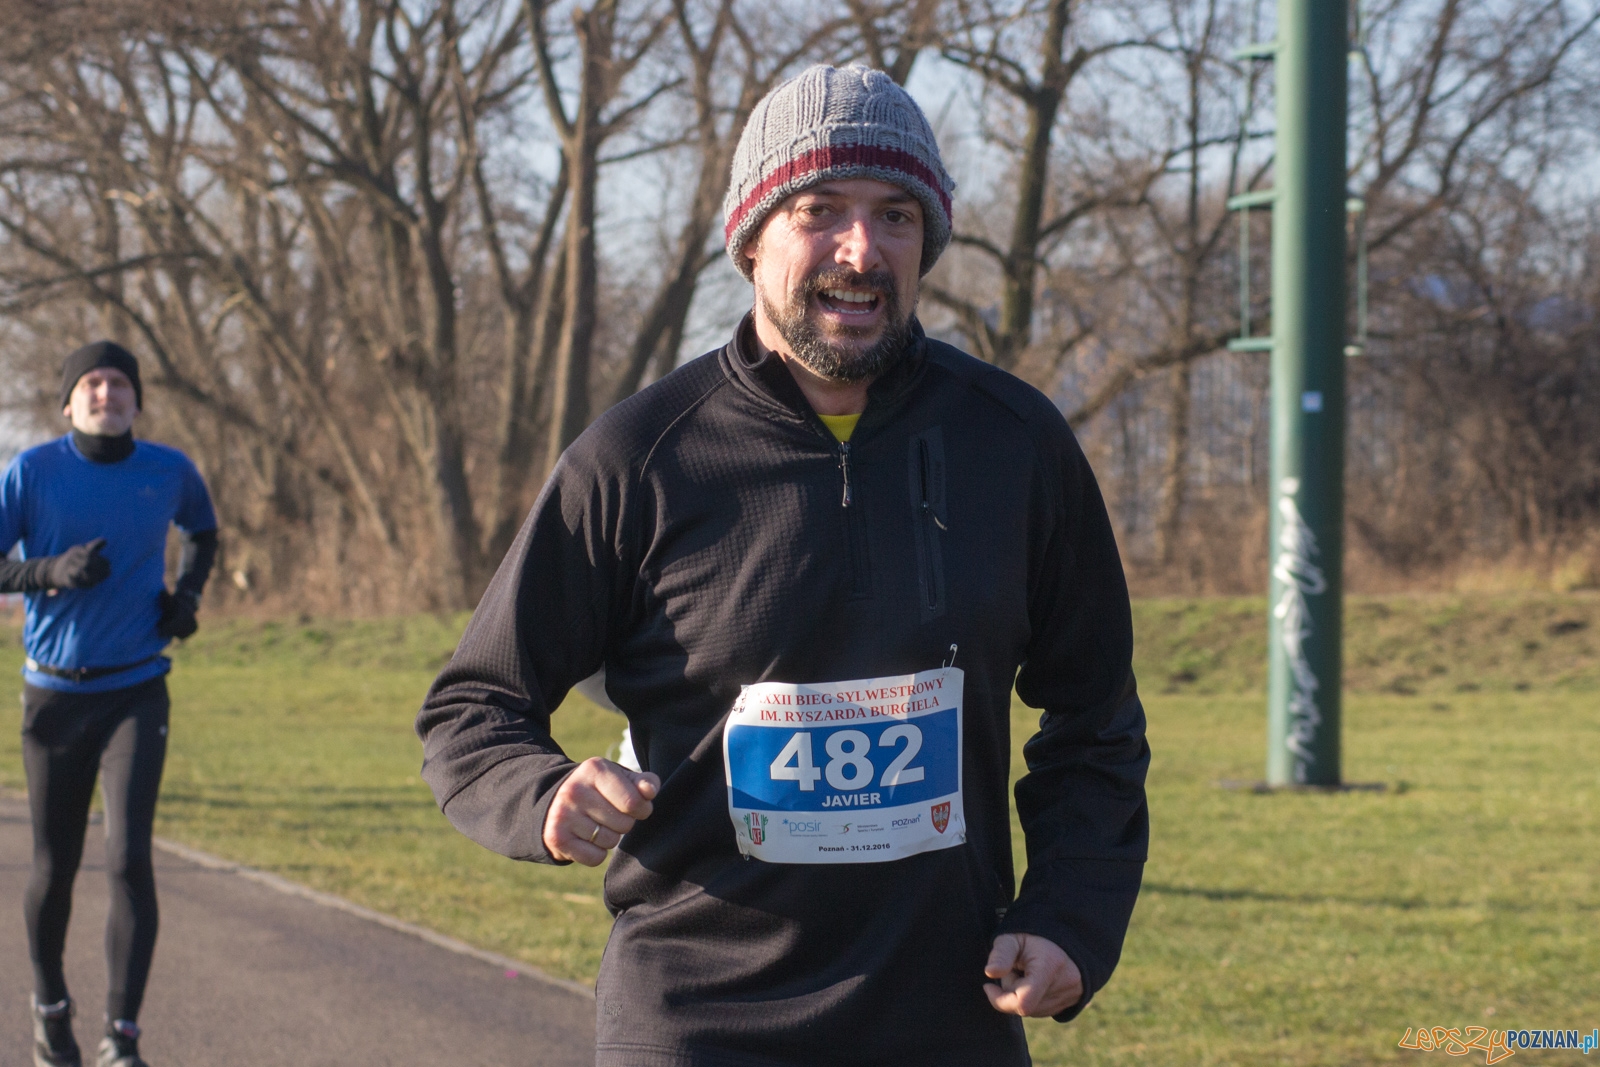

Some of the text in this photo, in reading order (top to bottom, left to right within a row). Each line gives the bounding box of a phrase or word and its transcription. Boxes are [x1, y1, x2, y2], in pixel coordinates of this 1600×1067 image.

[796, 693, 832, 706] BIEG
[836, 677, 945, 704] SYLWESTROWY
[760, 695, 940, 722] IM. RYSZARDA BURGIELA
[769, 723, 925, 792] 482
[821, 792, 882, 808] JAVIER
[789, 820, 821, 835] posir
[850, 843, 890, 852] 31.12.2016
